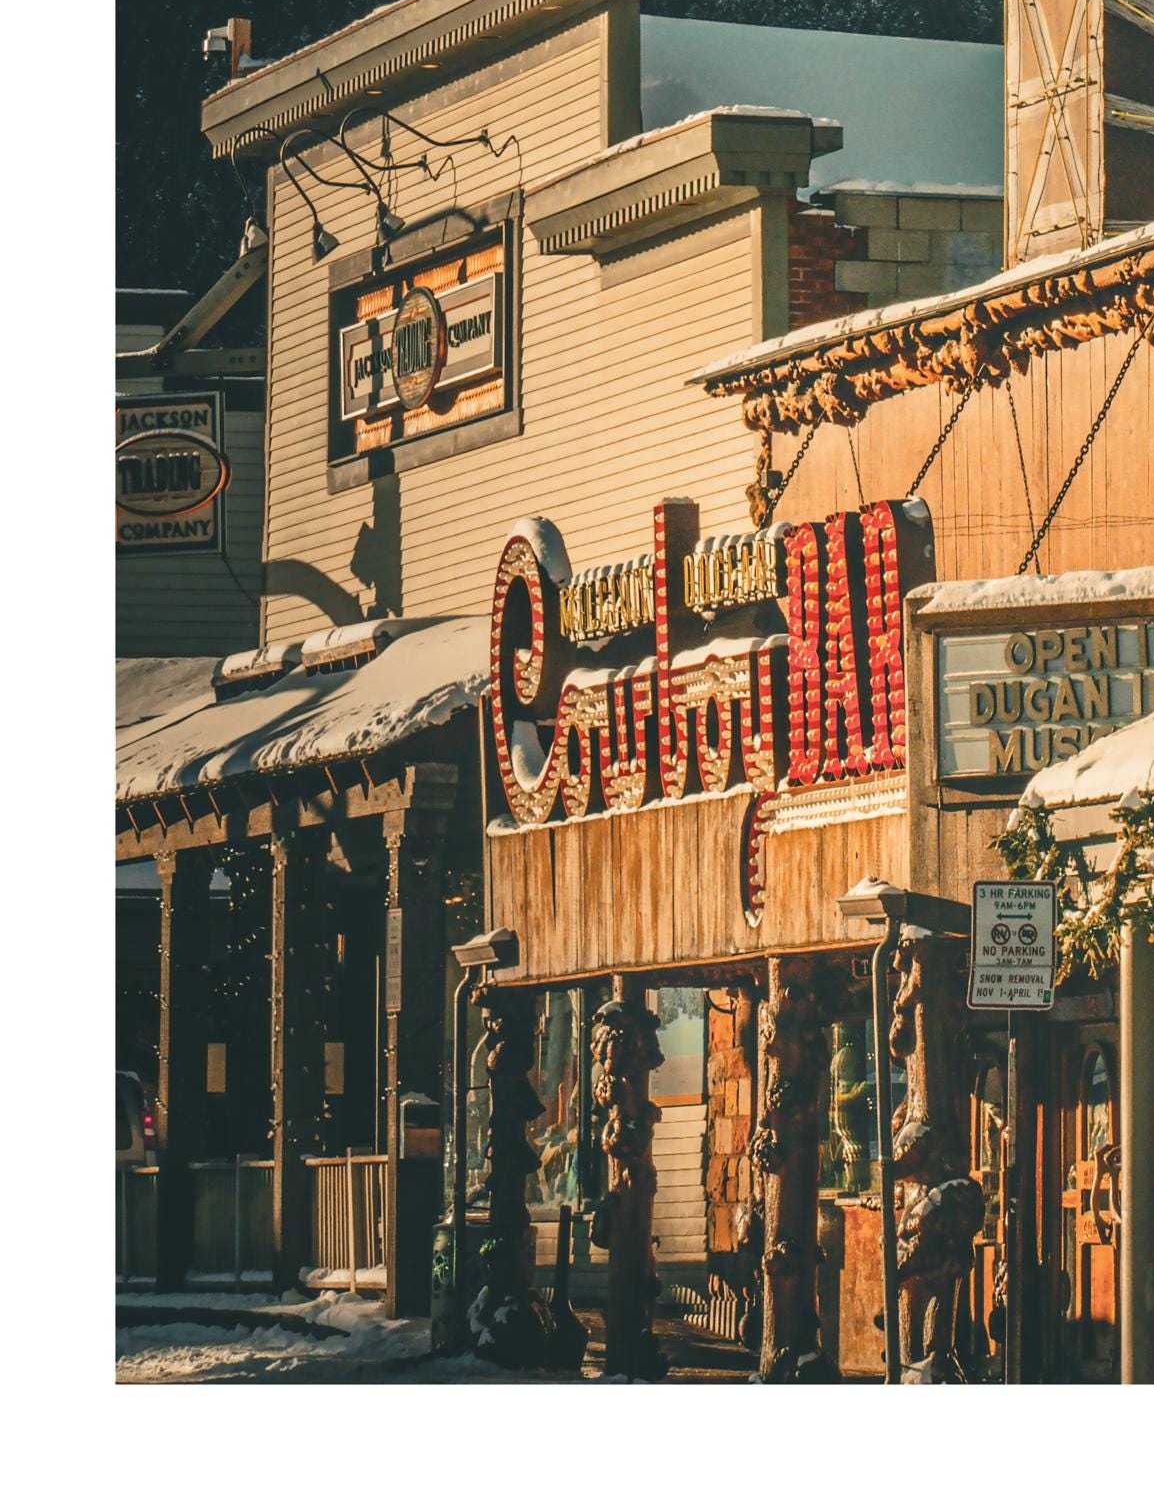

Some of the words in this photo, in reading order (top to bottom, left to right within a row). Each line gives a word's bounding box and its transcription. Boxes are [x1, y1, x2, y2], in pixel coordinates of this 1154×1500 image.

[448, 310, 492, 348] COMPANY
[395, 316, 433, 379] TRADING
[119, 409, 209, 434] JACKSON
[116, 452, 201, 495] TRADING
[119, 519, 212, 541] COMPANY
[784, 501, 907, 786] BAR
[1004, 625, 1120, 675] OPEN
[970, 674, 1111, 726] DUGAN
[979, 888, 986, 899] 3
[990, 889, 1004, 899] HR
[1008, 888, 1051, 899] PARKING
[994, 901, 1036, 910] 9AM-6PM
[982, 946, 996, 956] NO
[1001, 946, 1046, 956] PARKING
[976, 987, 994, 997] NOV
[979, 974, 1003, 984] SNOW
[1008, 974, 1045, 985] REMOVAL
